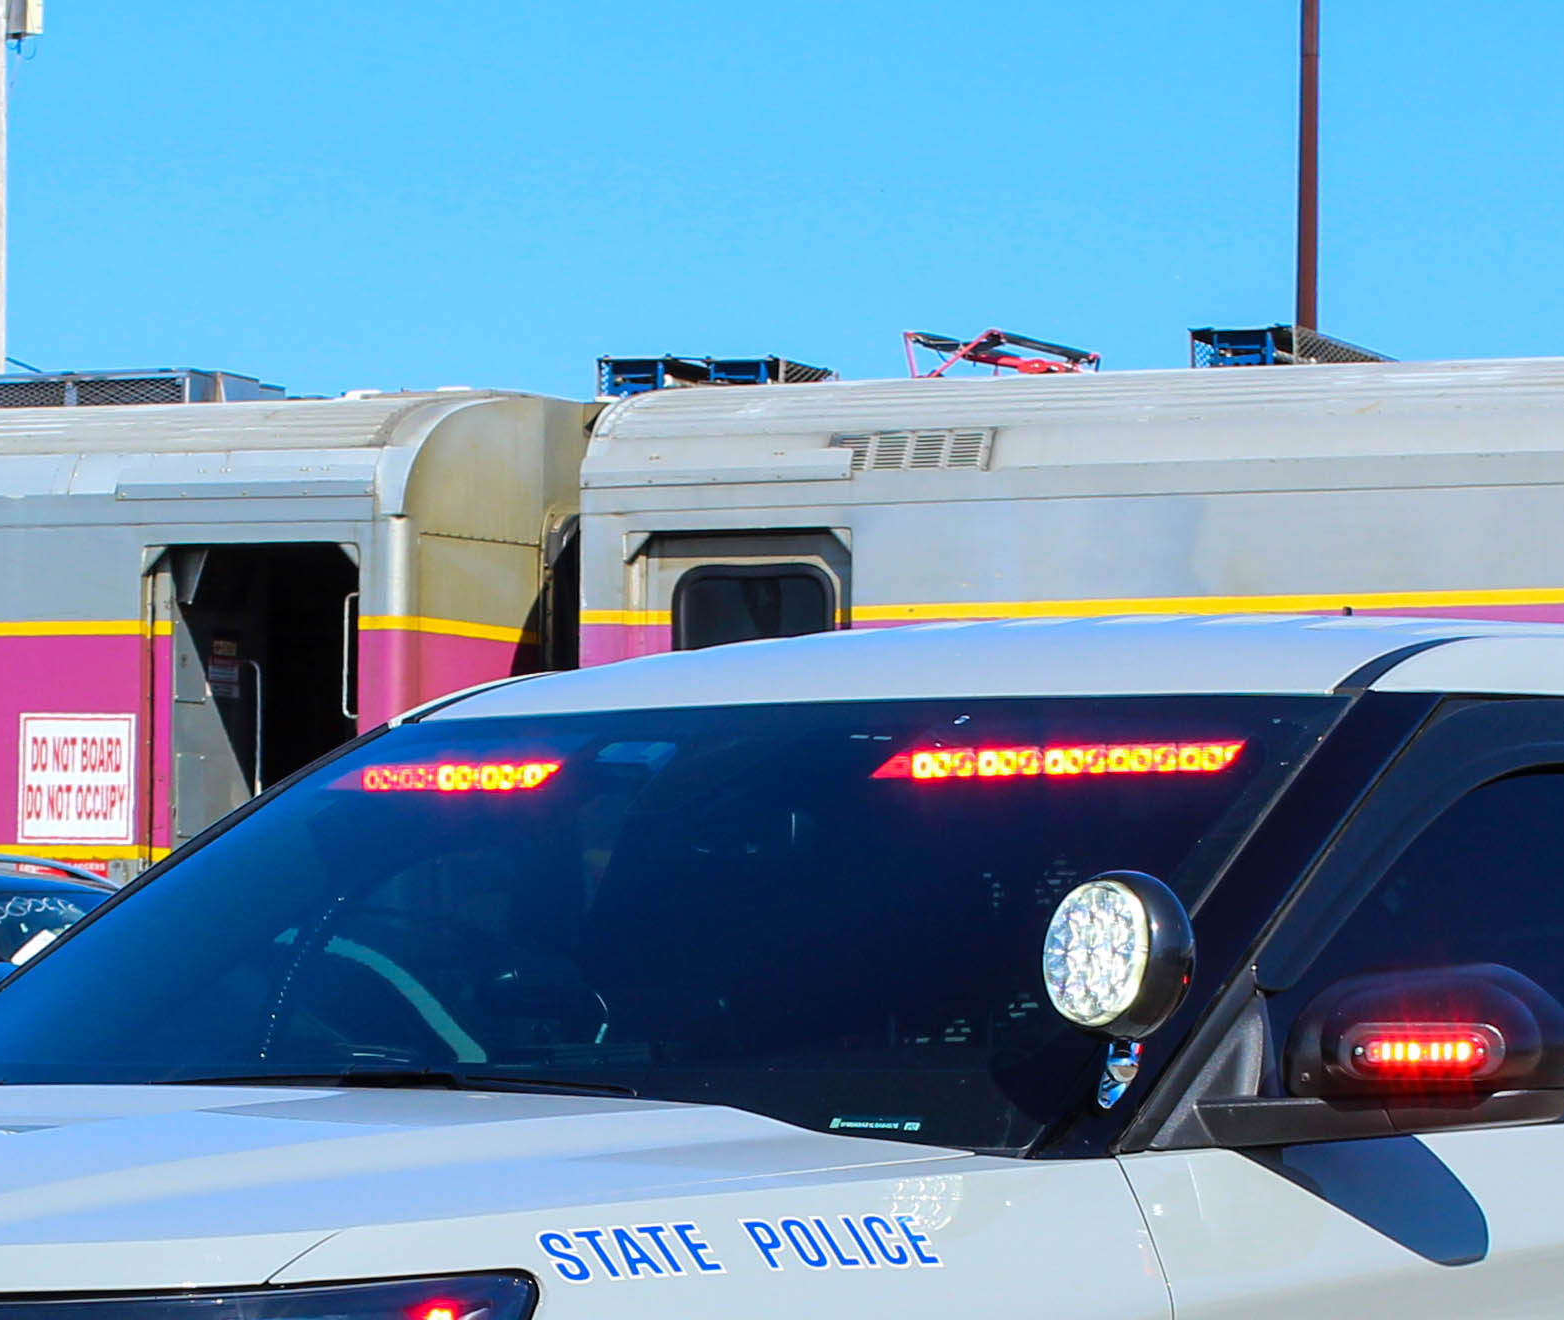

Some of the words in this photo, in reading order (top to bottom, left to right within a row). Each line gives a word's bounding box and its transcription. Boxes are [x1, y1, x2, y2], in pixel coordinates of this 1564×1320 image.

[31, 737, 48, 773] DO
[53, 737, 77, 773] NOT
[80, 737, 123, 773] BOARD
[26, 784, 43, 821] DO
[47, 784, 72, 821] NOT
[76, 784, 127, 821] OCCUPY
[538, 1222, 726, 1285] STATE
[740, 1213, 944, 1271] POLICE
